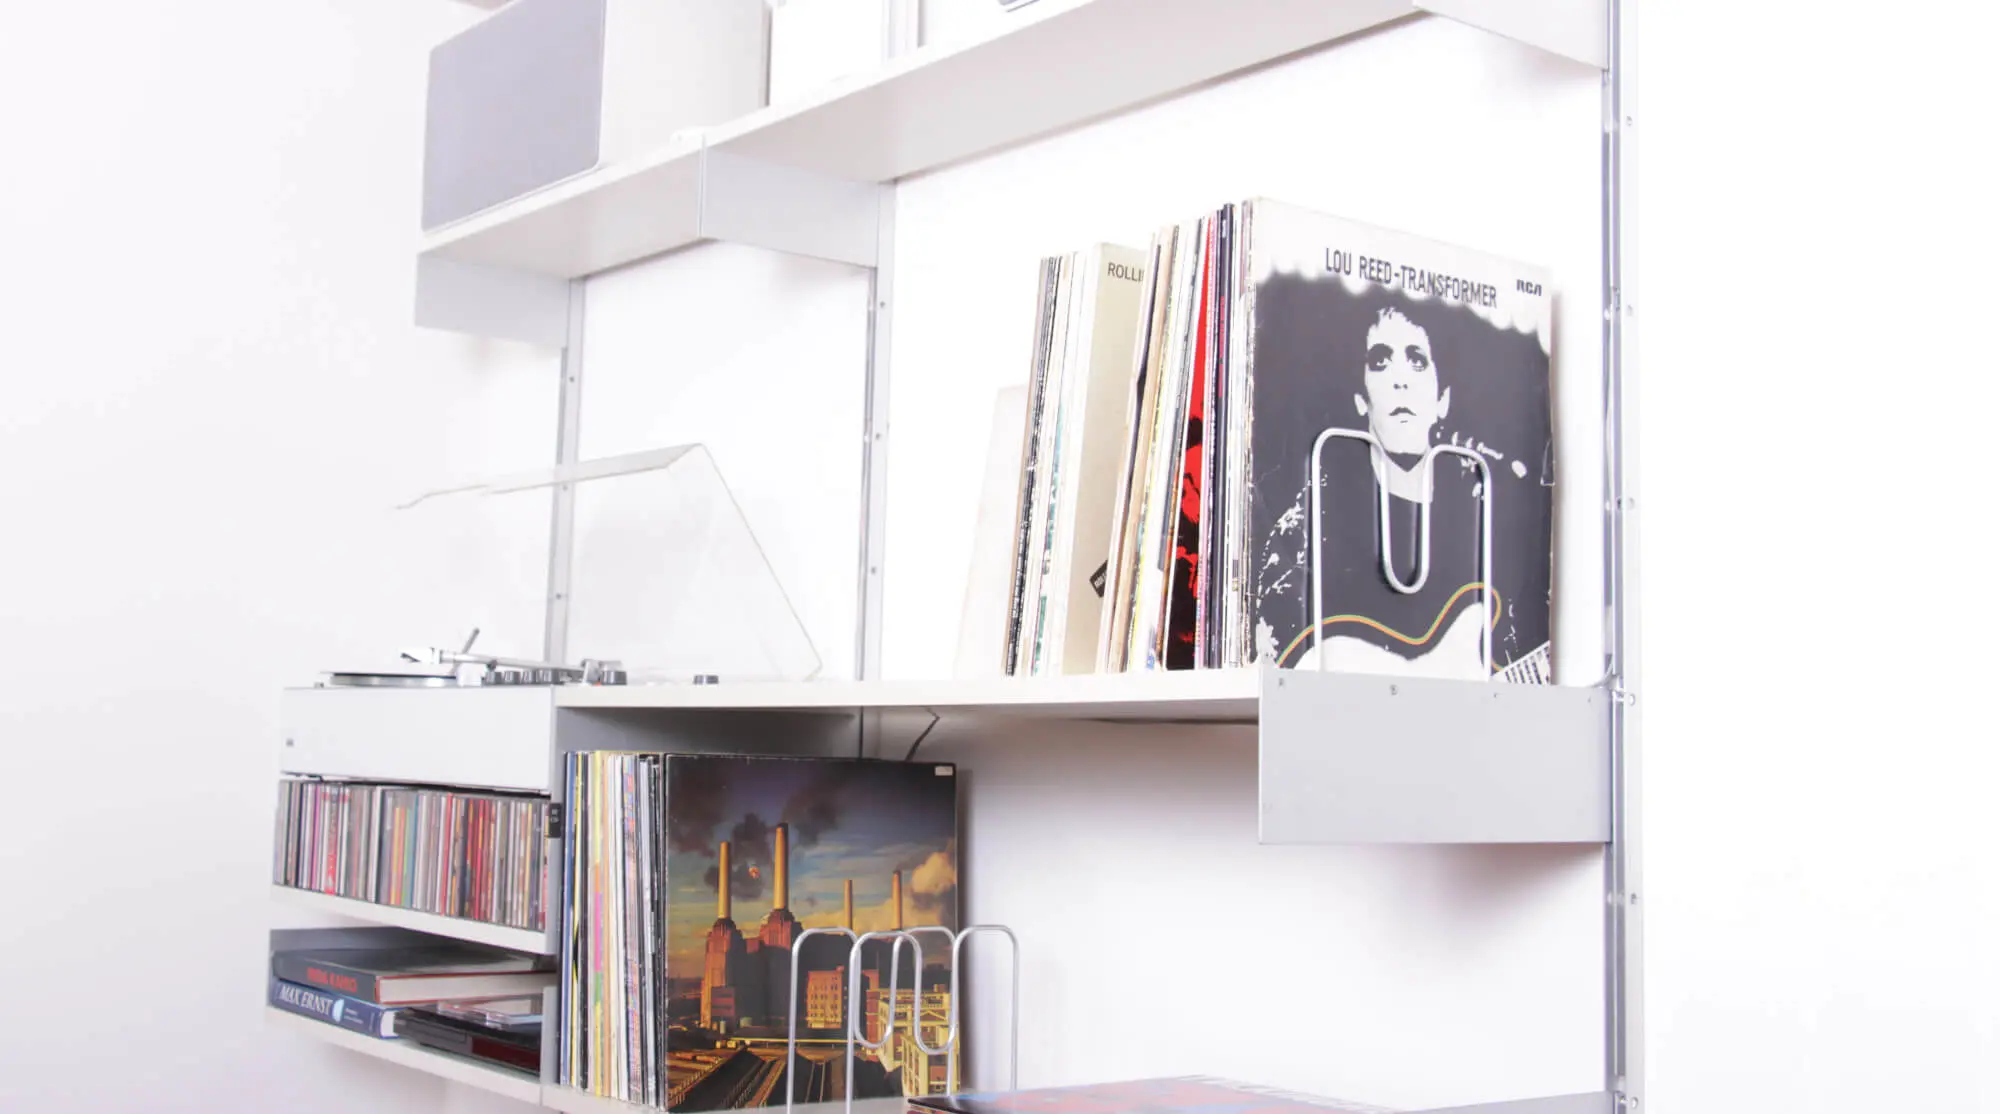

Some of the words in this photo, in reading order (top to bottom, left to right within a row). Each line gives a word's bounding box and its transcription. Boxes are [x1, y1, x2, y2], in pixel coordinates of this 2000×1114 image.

[1325, 247, 1352, 275] LOU
[1516, 279, 1542, 297] RCA
[280, 983, 301, 1005] MAX
[301, 991, 333, 1015] ERNST
